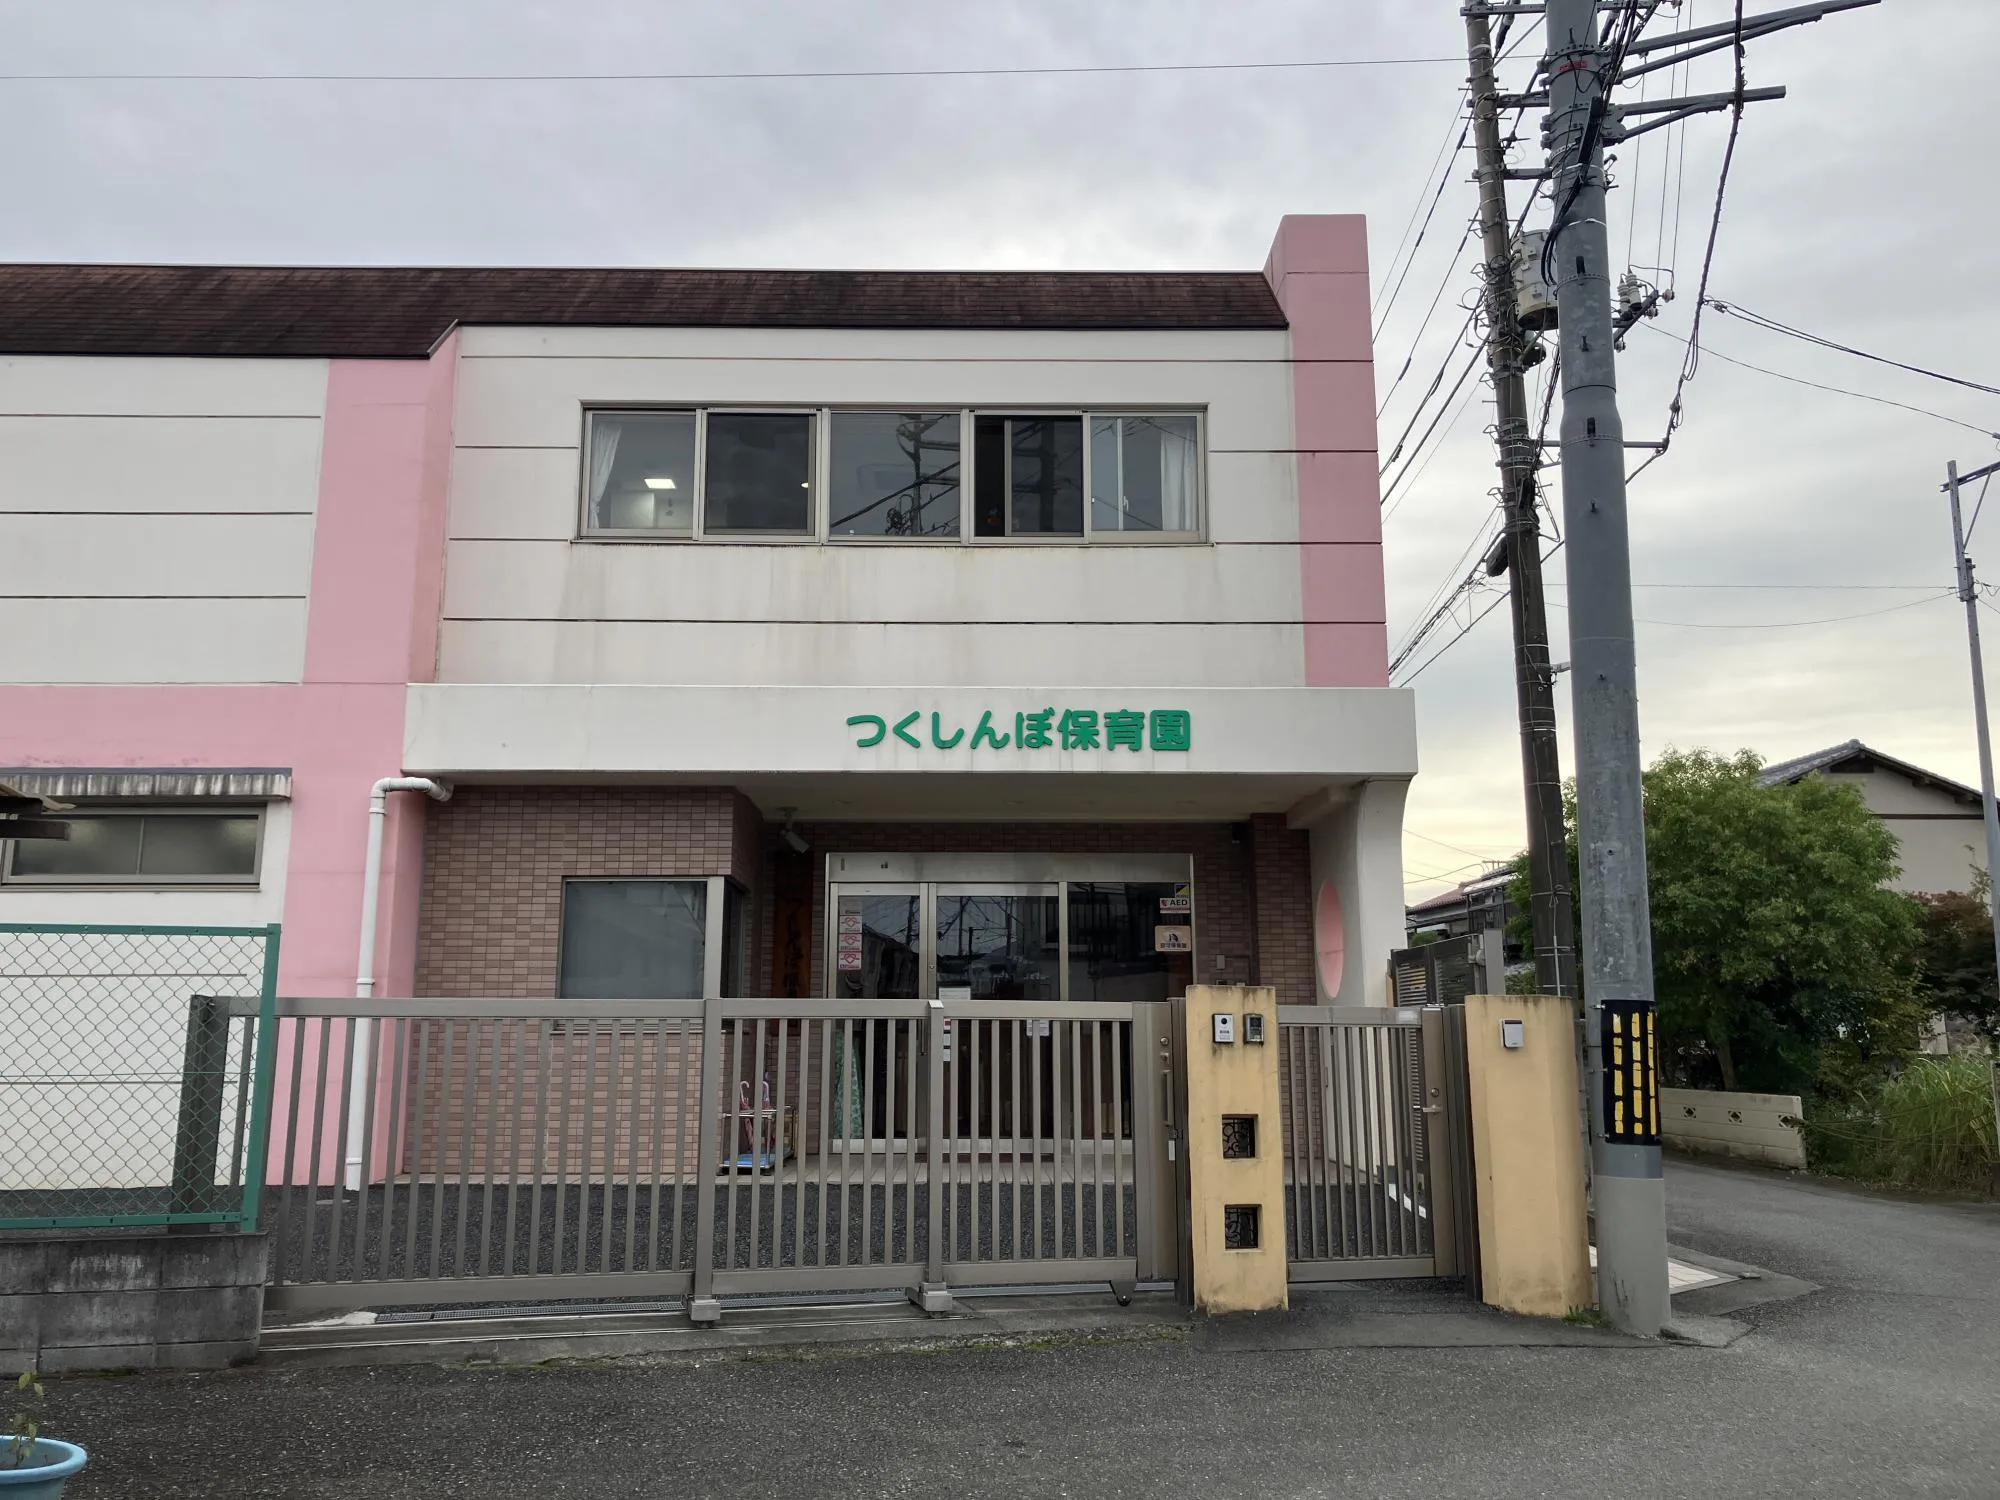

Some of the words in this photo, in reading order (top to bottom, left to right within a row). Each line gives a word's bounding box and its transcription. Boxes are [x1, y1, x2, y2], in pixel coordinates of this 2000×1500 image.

[846, 707, 1191, 752] つくしんぼ保育園
